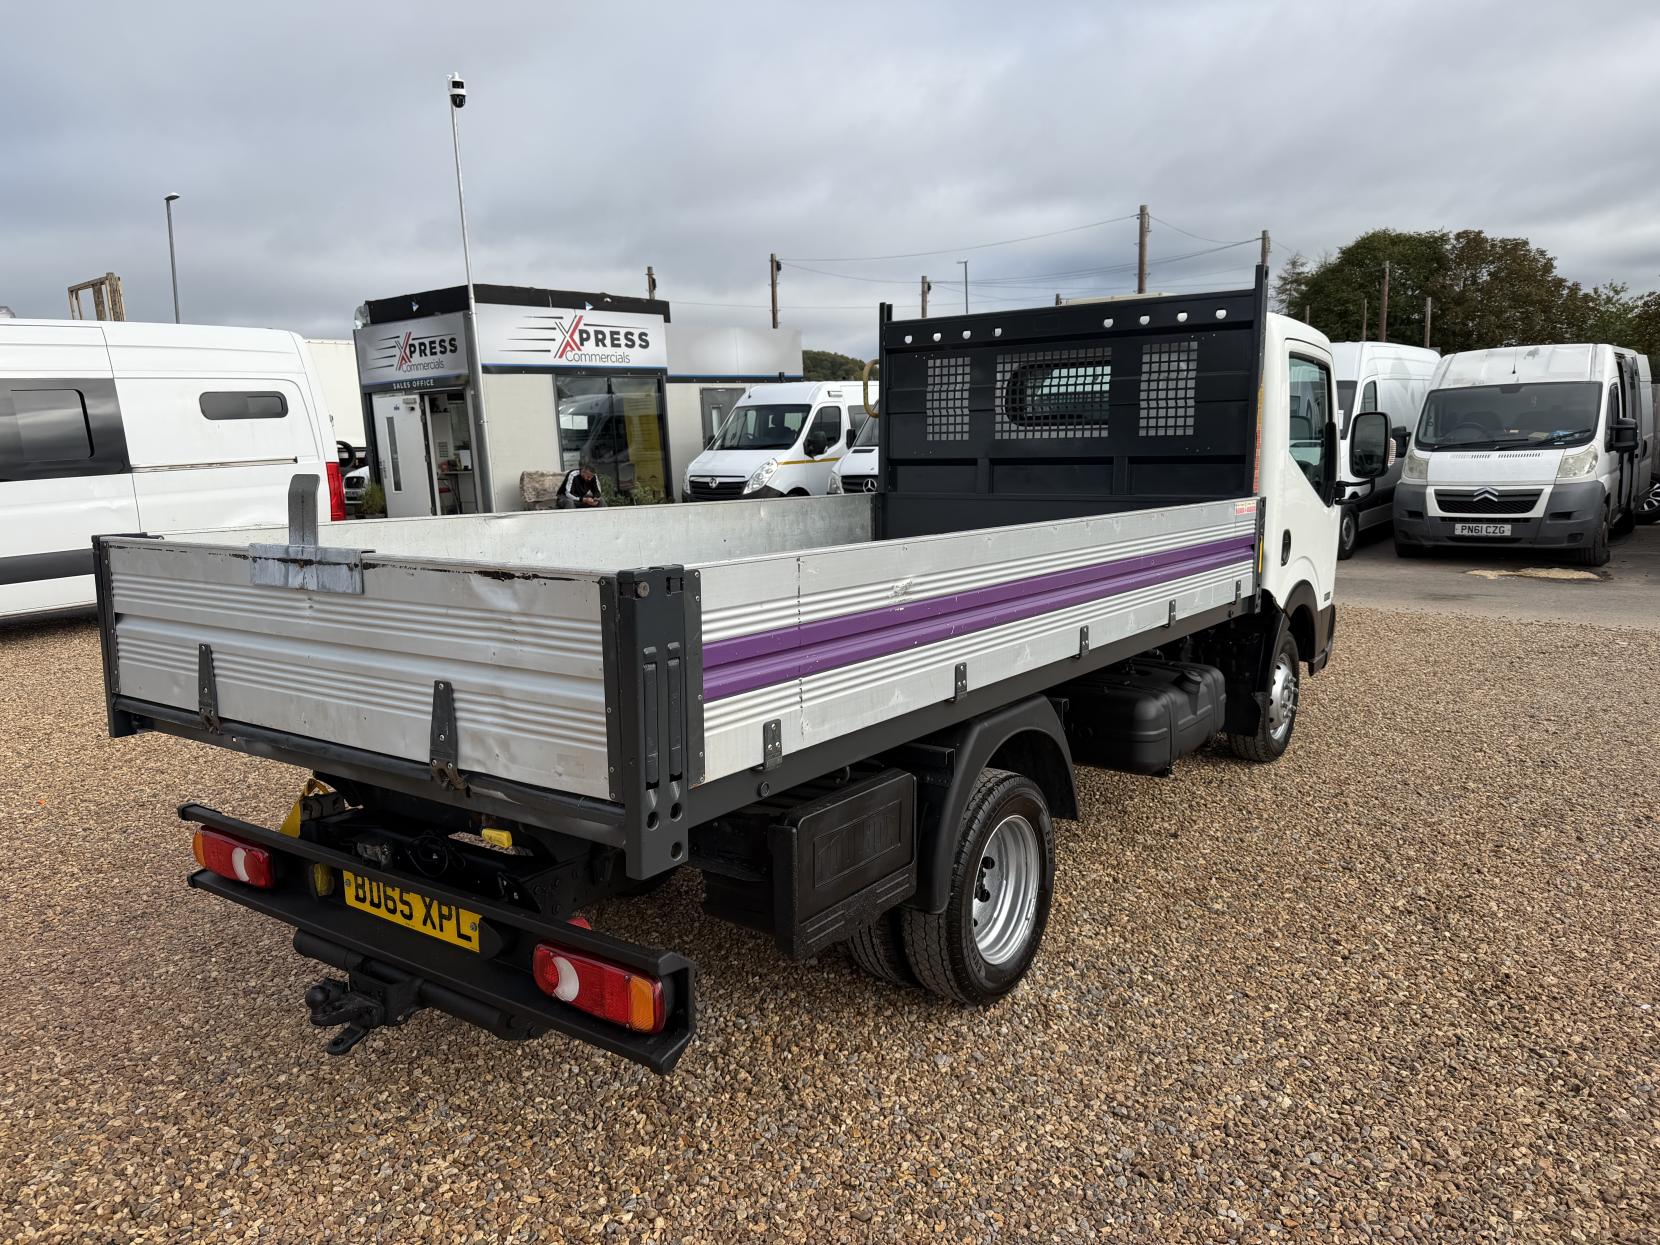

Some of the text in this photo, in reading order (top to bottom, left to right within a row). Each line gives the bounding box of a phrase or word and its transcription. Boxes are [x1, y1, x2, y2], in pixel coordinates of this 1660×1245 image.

[554, 314, 650, 359] XPRESS
[395, 331, 458, 372] XPRESS
[565, 350, 631, 364] Commercials
[401, 358, 446, 373] Commercials
[393, 379, 434, 390] SALES OFFICE
[1460, 525, 1505, 535] PN61 CZG
[354, 874, 473, 943] BD65 XPL
